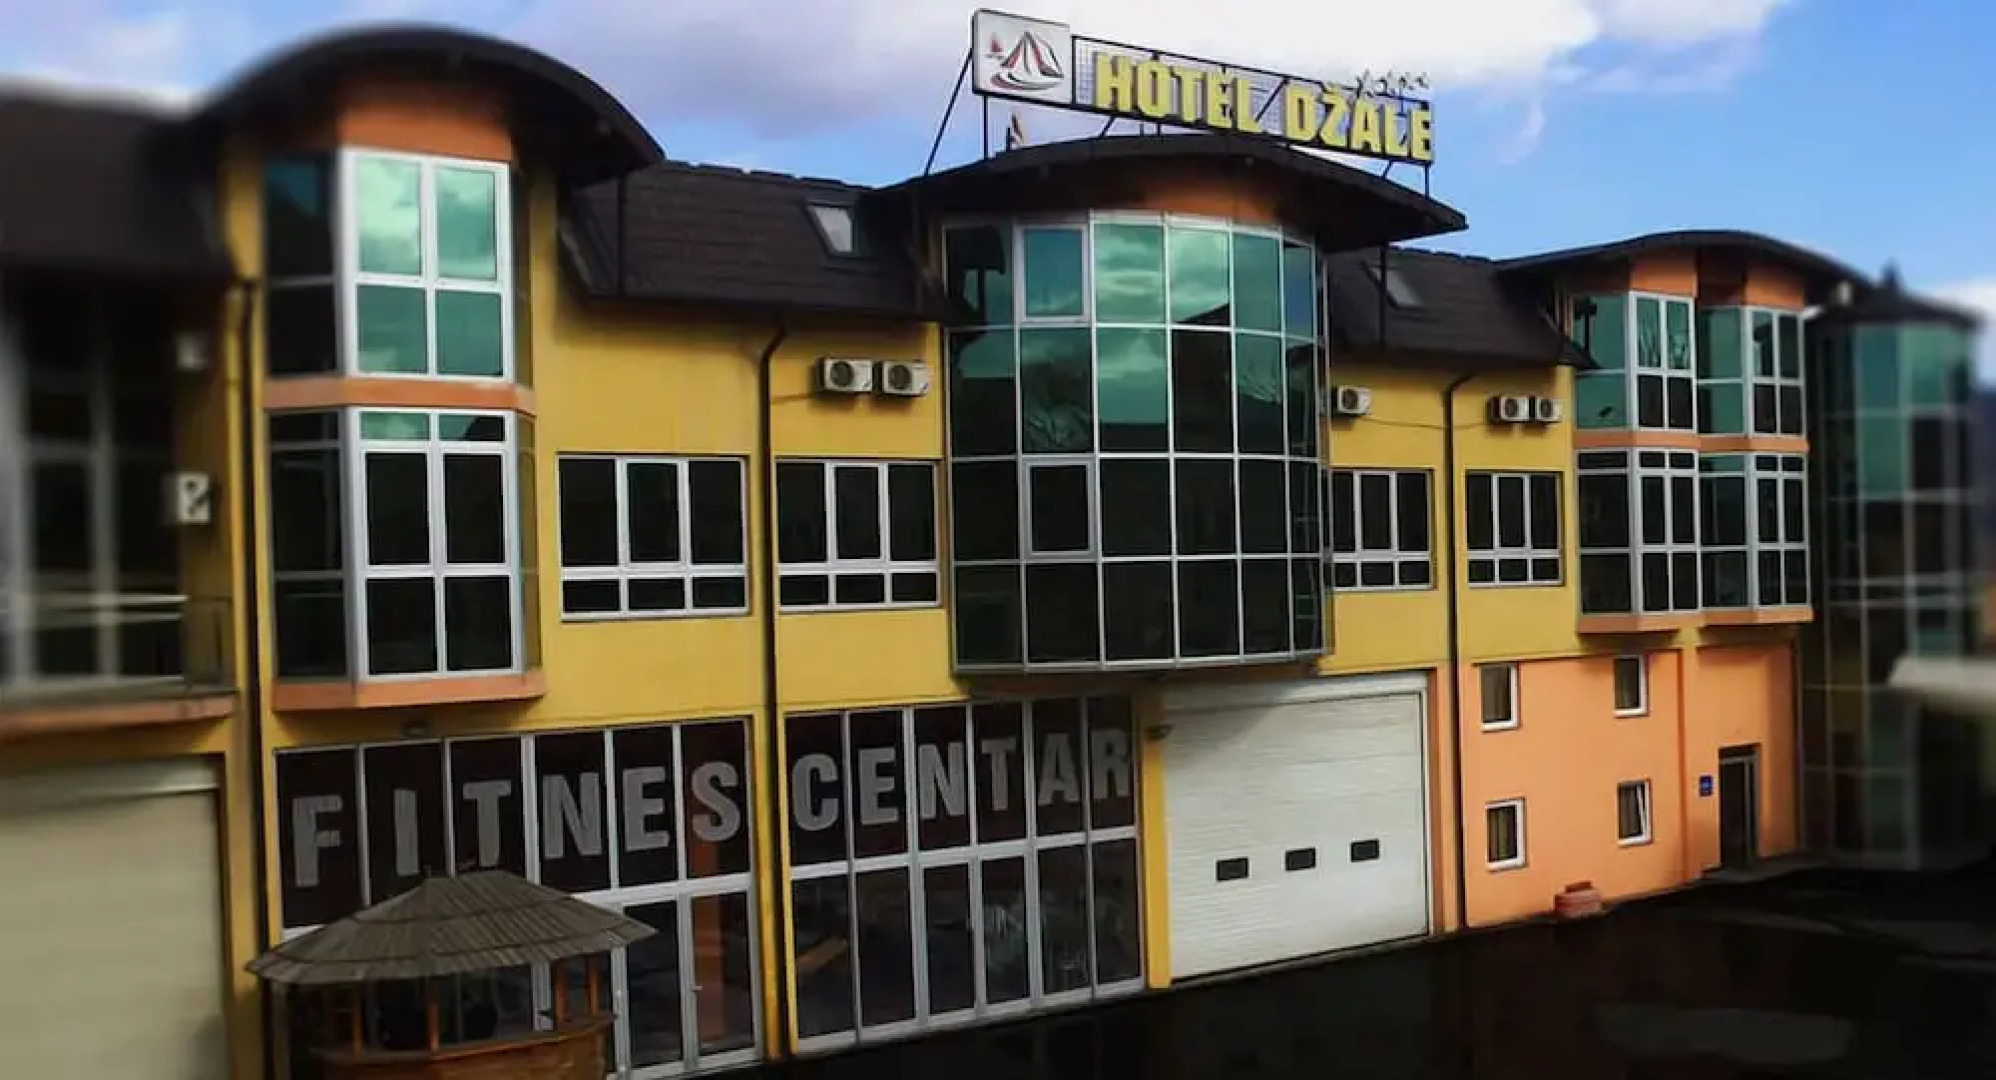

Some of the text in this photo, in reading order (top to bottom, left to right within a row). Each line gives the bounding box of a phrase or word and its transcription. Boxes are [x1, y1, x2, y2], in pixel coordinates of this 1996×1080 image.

[1095, 53, 1433, 160] HOTEL DŽALE
[292, 728, 1131, 887] FITNES CENTAR
